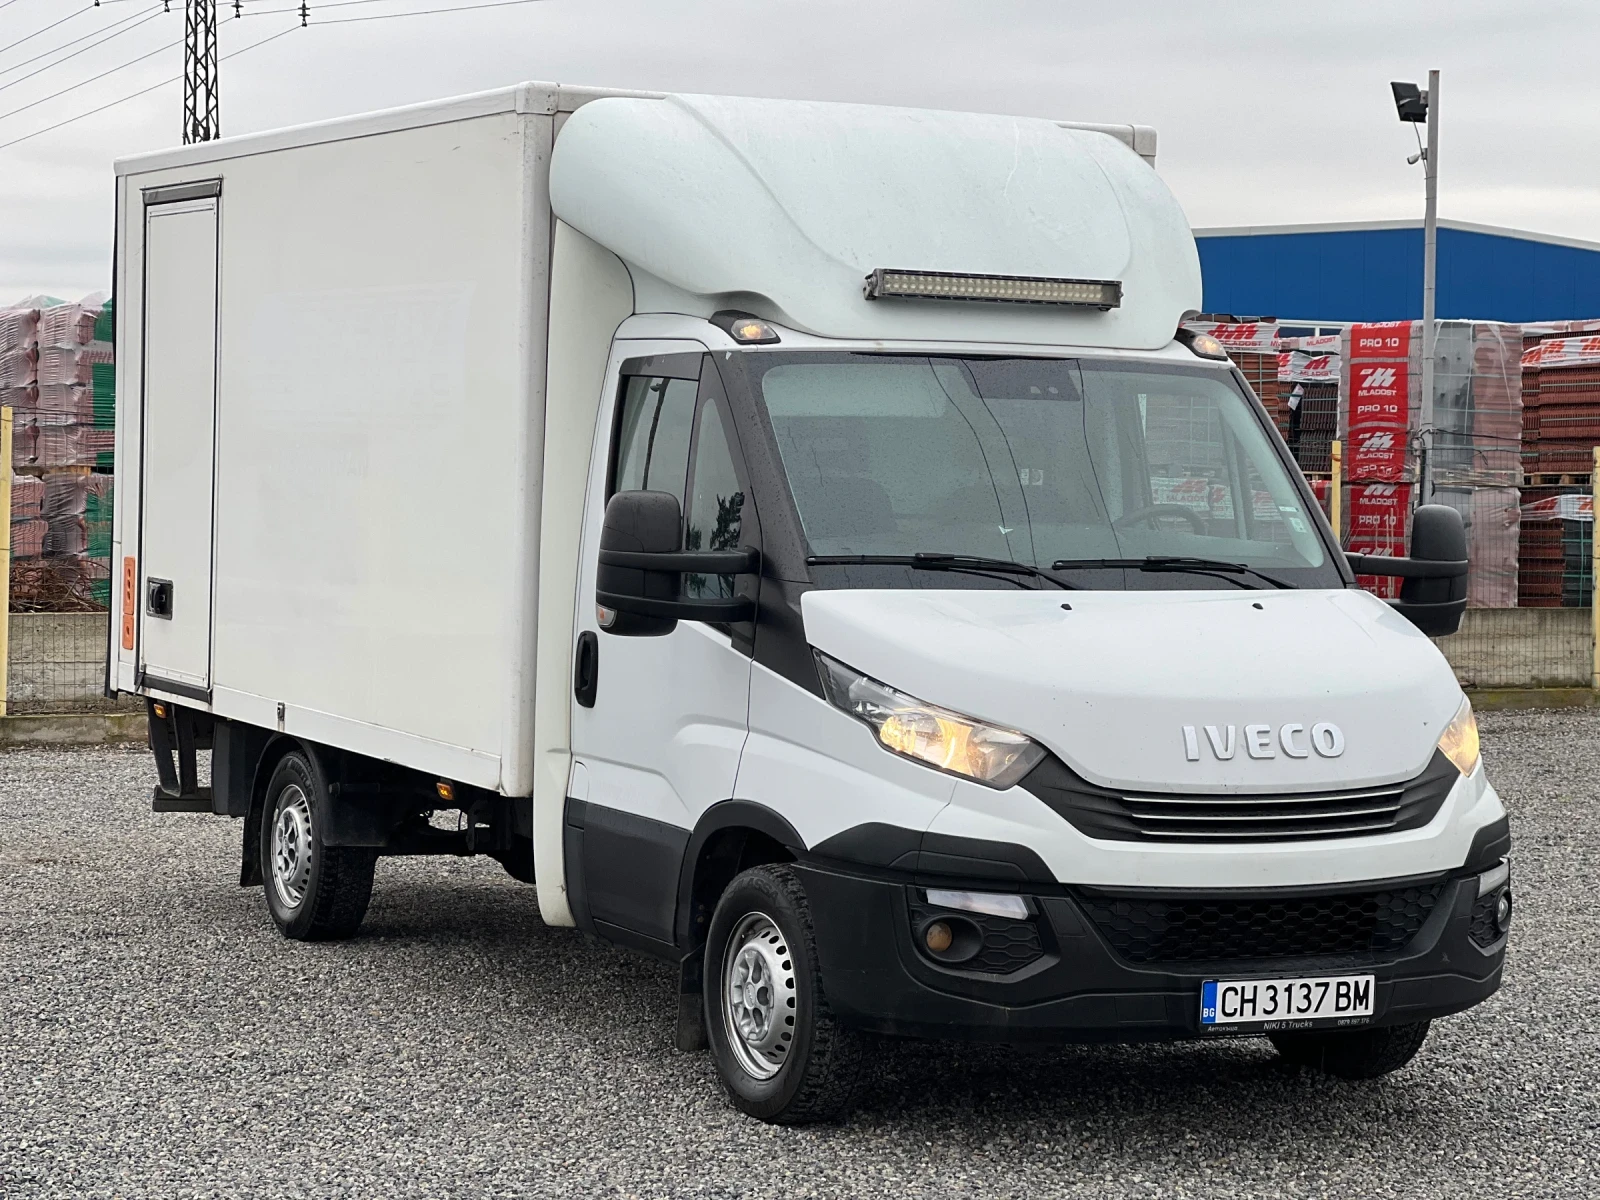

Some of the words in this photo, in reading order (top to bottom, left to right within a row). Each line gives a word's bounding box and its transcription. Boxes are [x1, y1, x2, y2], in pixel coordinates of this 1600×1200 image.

[1306, 337, 1337, 347] MLADOST
[1359, 338, 1382, 347] PRO
[1385, 337, 1400, 347] 10
[1358, 388, 1397, 397] MLADOST
[1357, 404, 1381, 414] PRO
[1383, 404, 1398, 413] 10
[1356, 452, 1395, 460] MLADOST
[1359, 497, 1398, 505] MLADOST
[1358, 515, 1381, 525] PRO
[1383, 515, 1397, 525] 10
[1182, 722, 1346, 762] IVECO
[1221, 985, 1258, 1018] CH
[1262, 981, 1330, 1015] 3137
[1334, 979, 1370, 1013] BM
[1202, 1007, 1215, 1018] BG
[1281, 1021, 1286, 1029] 5
[1288, 1020, 1313, 1029] Trucks
